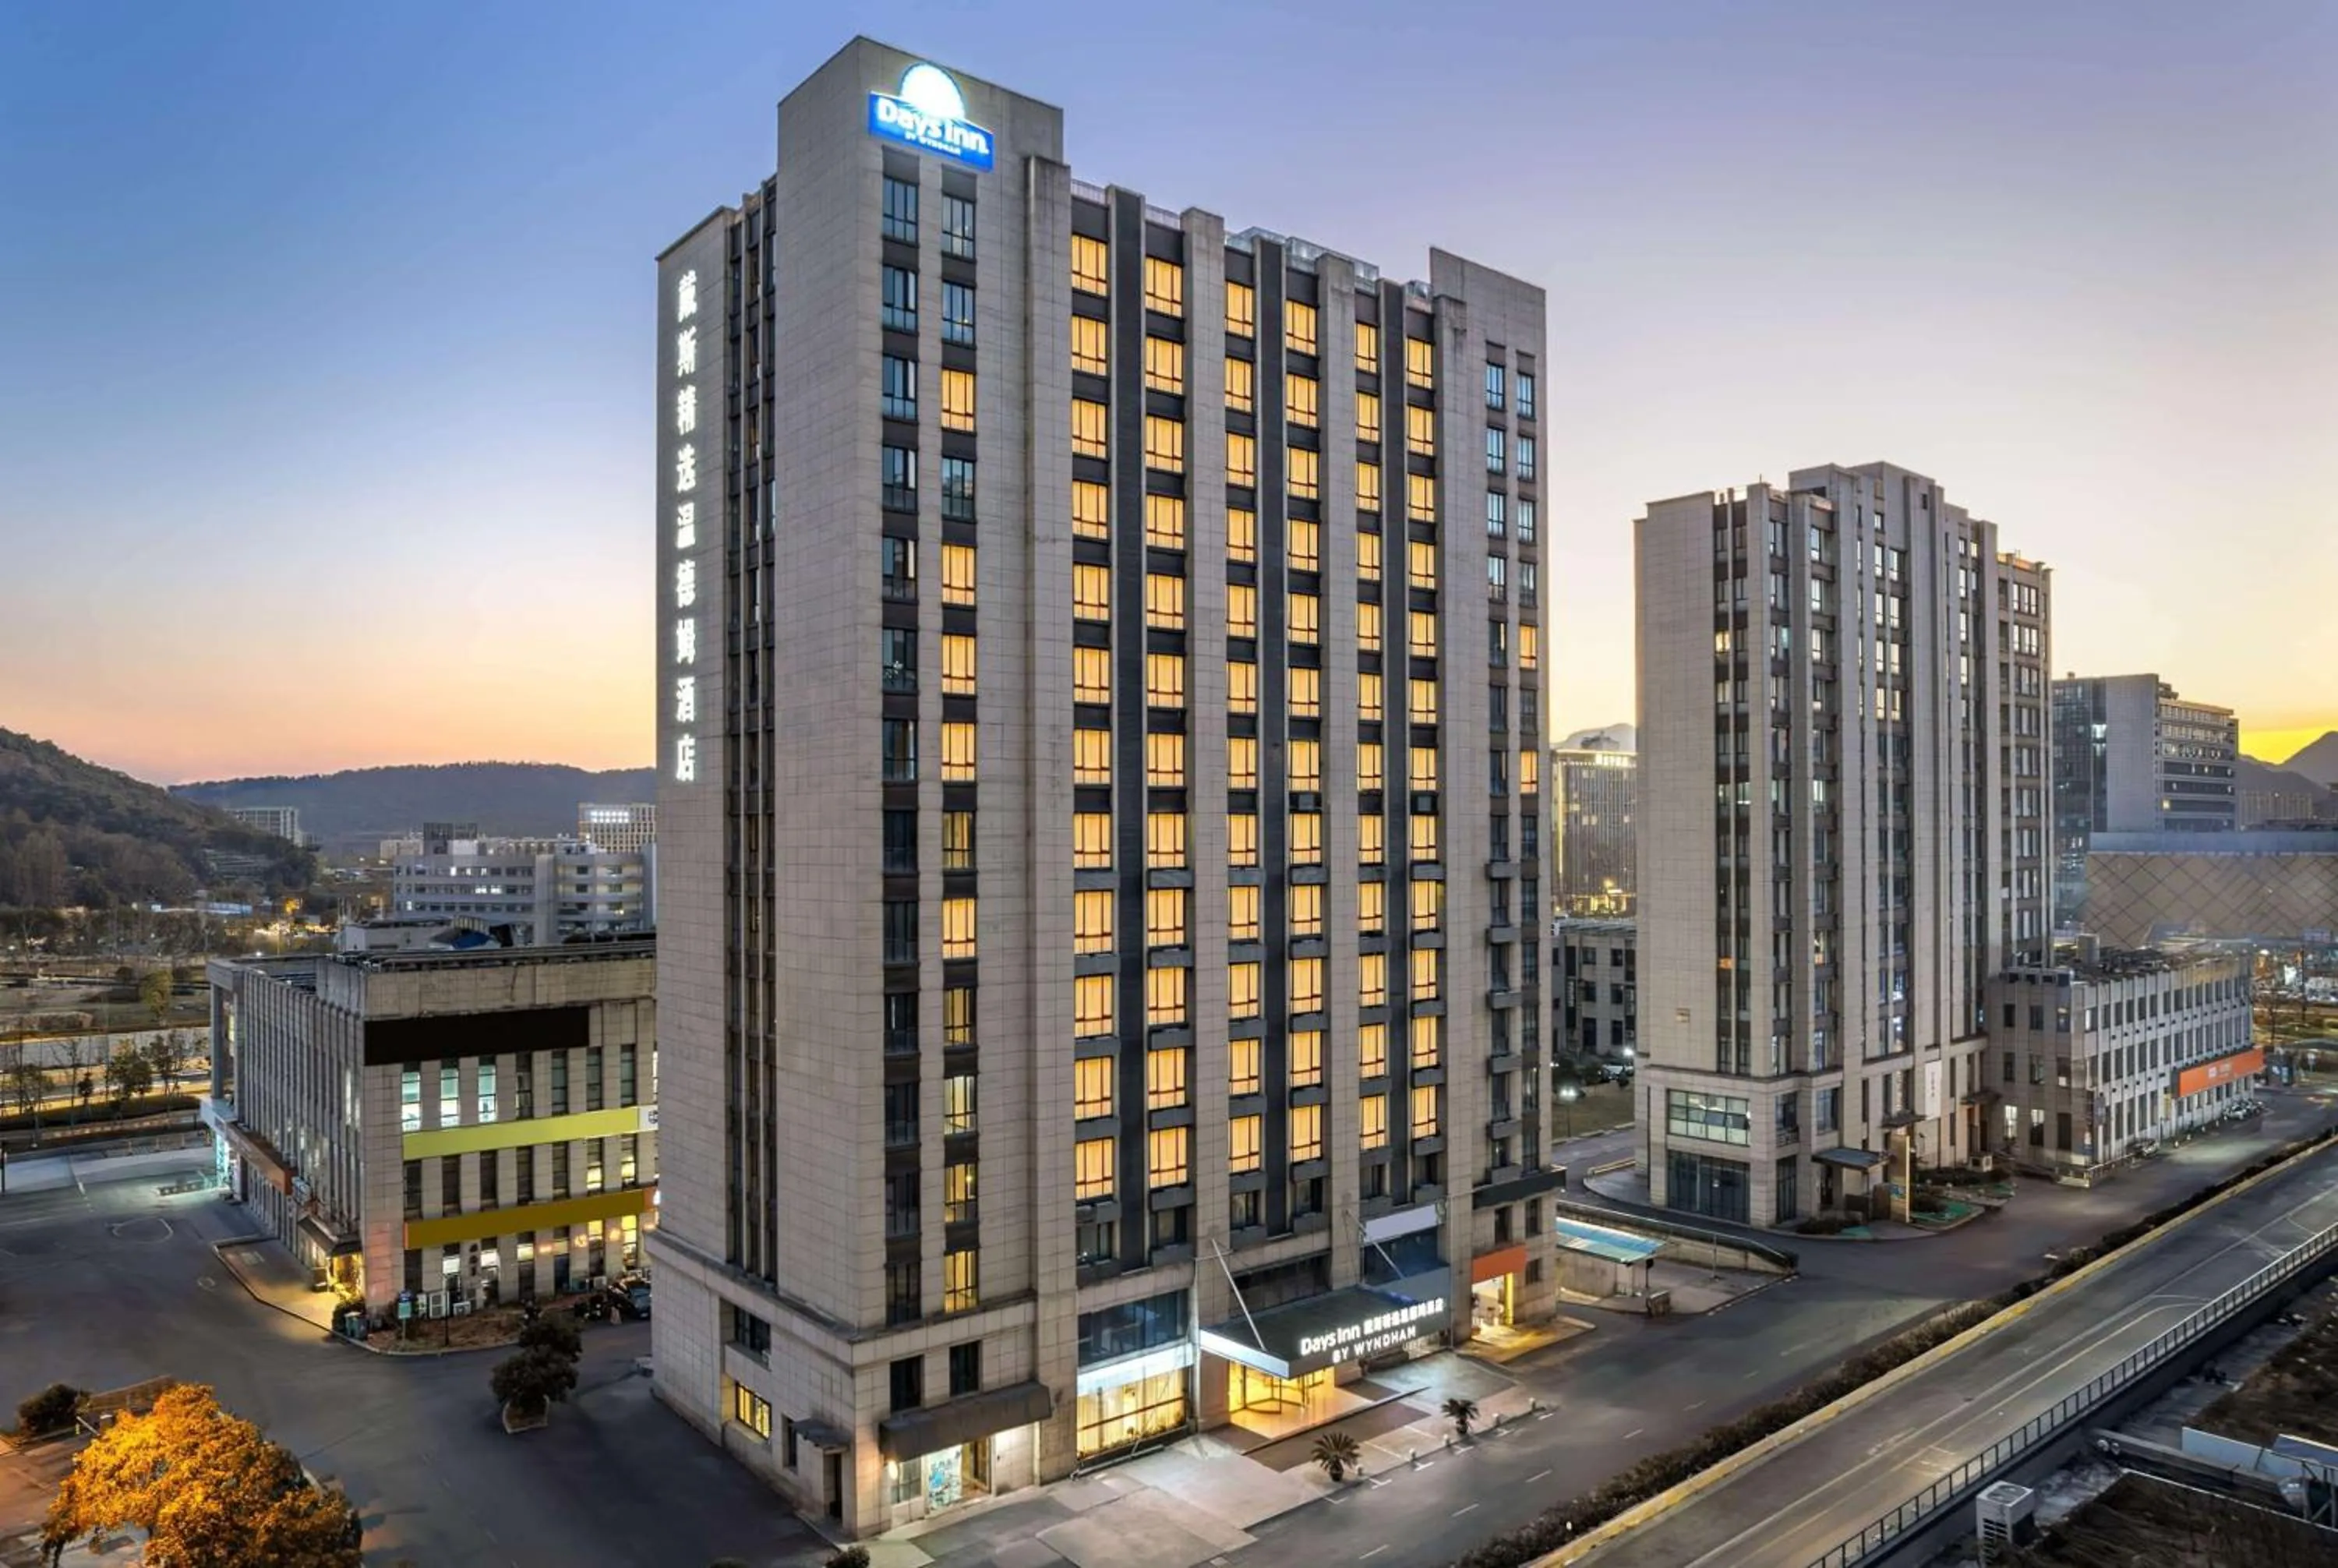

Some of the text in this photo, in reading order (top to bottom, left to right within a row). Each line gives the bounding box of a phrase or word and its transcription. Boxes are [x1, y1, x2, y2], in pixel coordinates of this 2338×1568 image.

[878, 97, 942, 138] Days
[945, 119, 987, 153] Inn
[1301, 1325, 1360, 1355] Days Inn
[1333, 1347, 1348, 1363] BY
[1354, 1326, 1416, 1355] WYNDHAM
